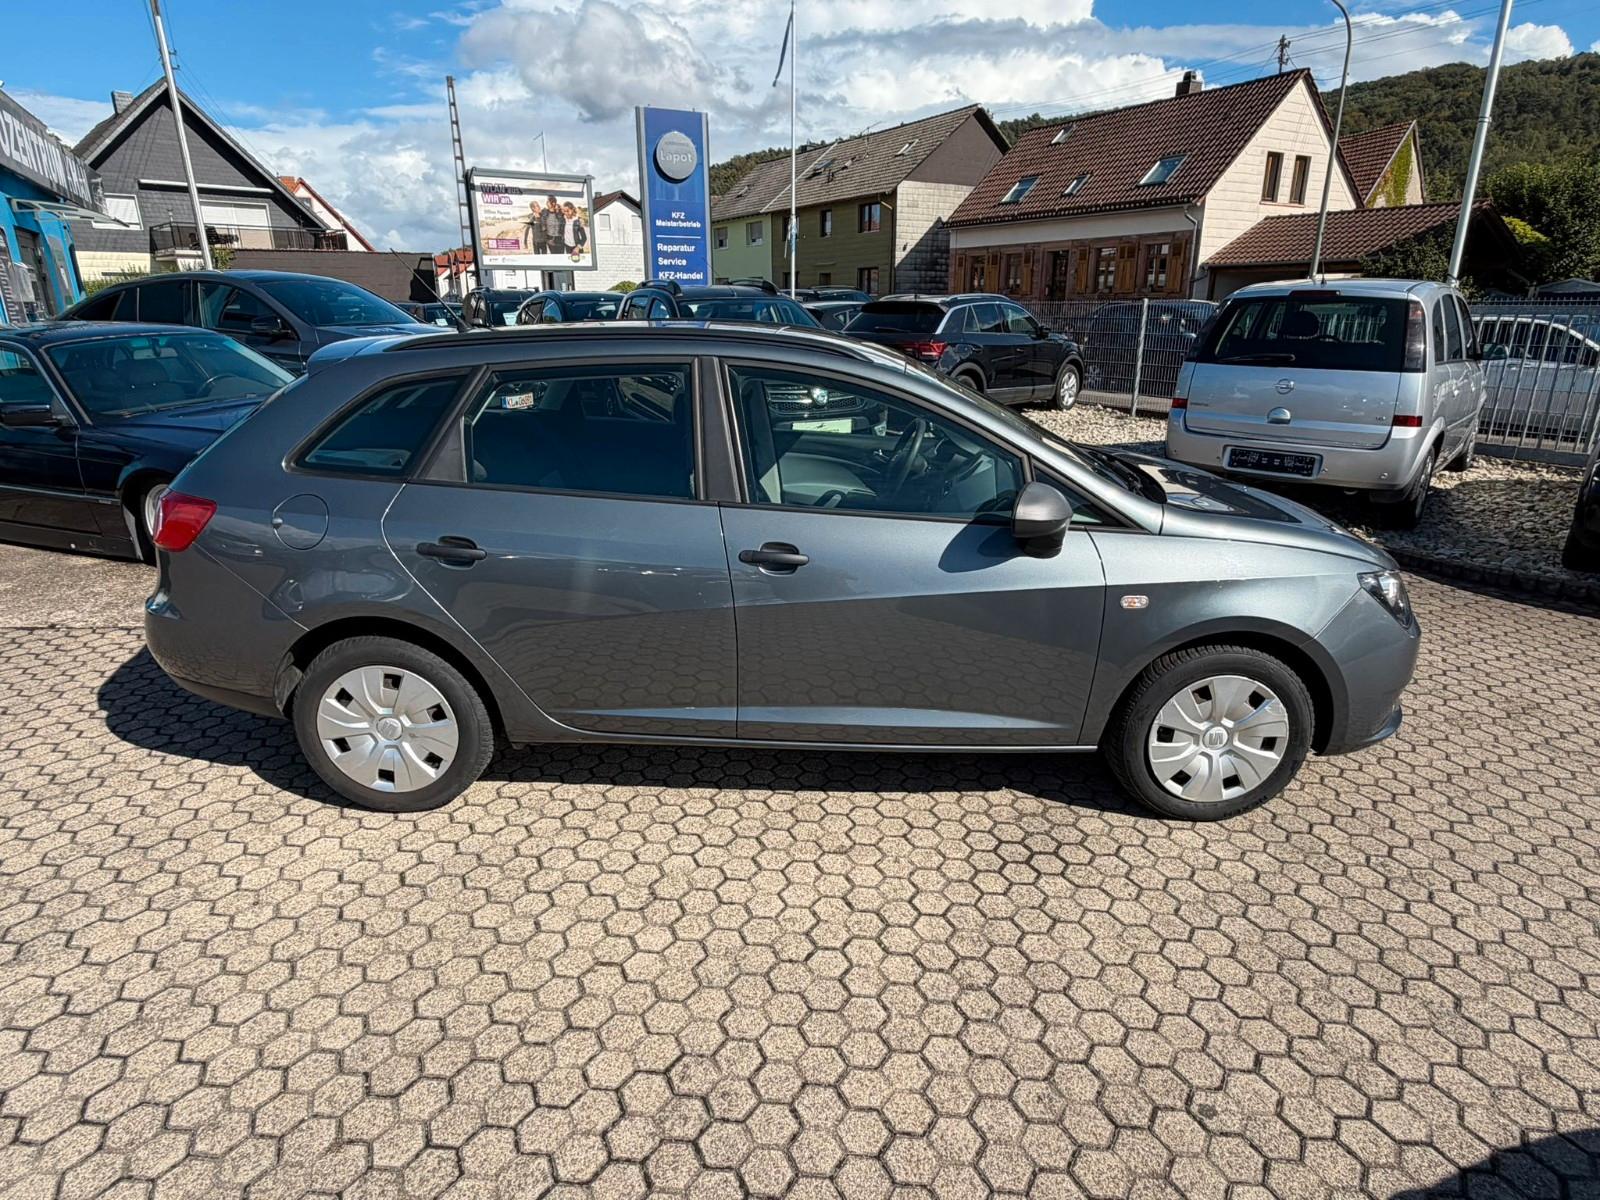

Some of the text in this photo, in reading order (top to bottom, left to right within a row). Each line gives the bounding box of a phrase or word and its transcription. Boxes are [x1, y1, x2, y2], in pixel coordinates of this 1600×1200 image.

[660, 150, 692, 164] Lapot
[481, 183, 506, 194] WLAN
[482, 193, 513, 205] WIR an.
[671, 211, 686, 219] KFZ
[655, 219, 701, 228] Meisterbetrieb
[657, 243, 695, 253] Reparatur
[658, 257, 687, 266] Service
[658, 271, 703, 279] KFZ-Handel
